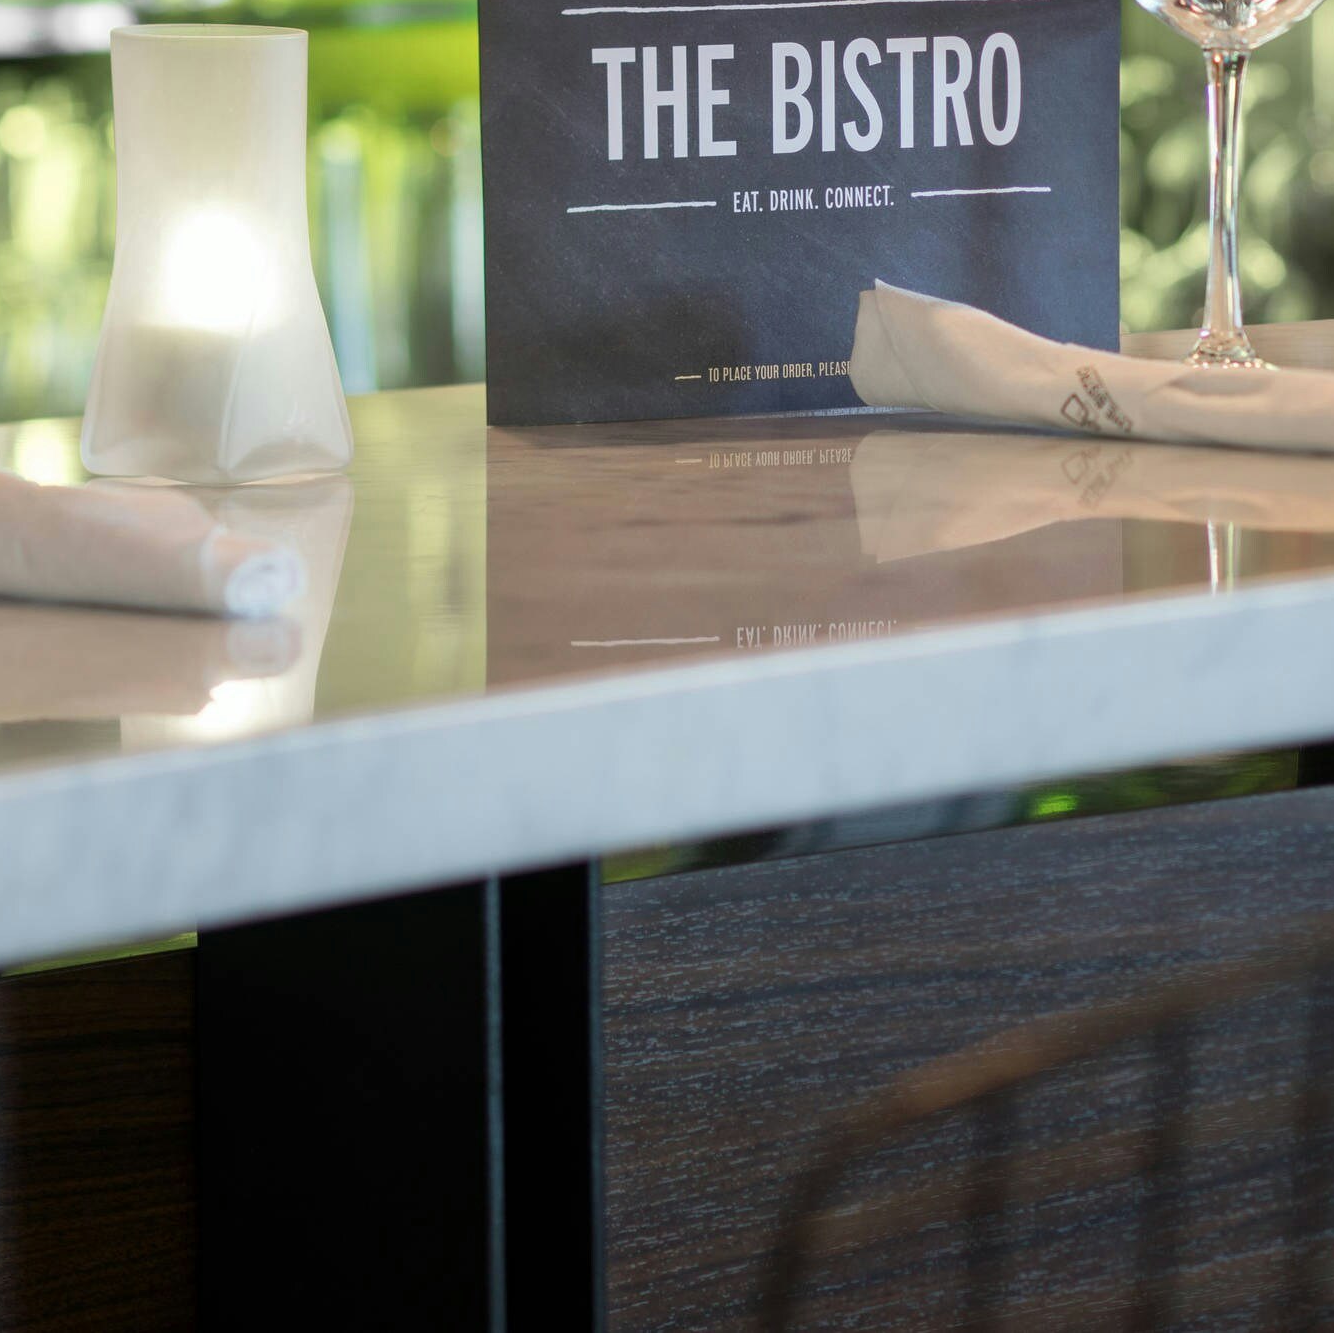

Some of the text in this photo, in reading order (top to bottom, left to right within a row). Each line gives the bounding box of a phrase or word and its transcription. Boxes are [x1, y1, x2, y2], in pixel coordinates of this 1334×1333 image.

[591, 32, 1022, 161] THE BISTRO
[733, 185, 895, 213] EAT. DRINK. CONNECT.
[708, 367, 720, 383] TO
[723, 365, 752, 382] PLACE
[755, 364, 780, 381] YOUR
[782, 363, 816, 379] ORDER,
